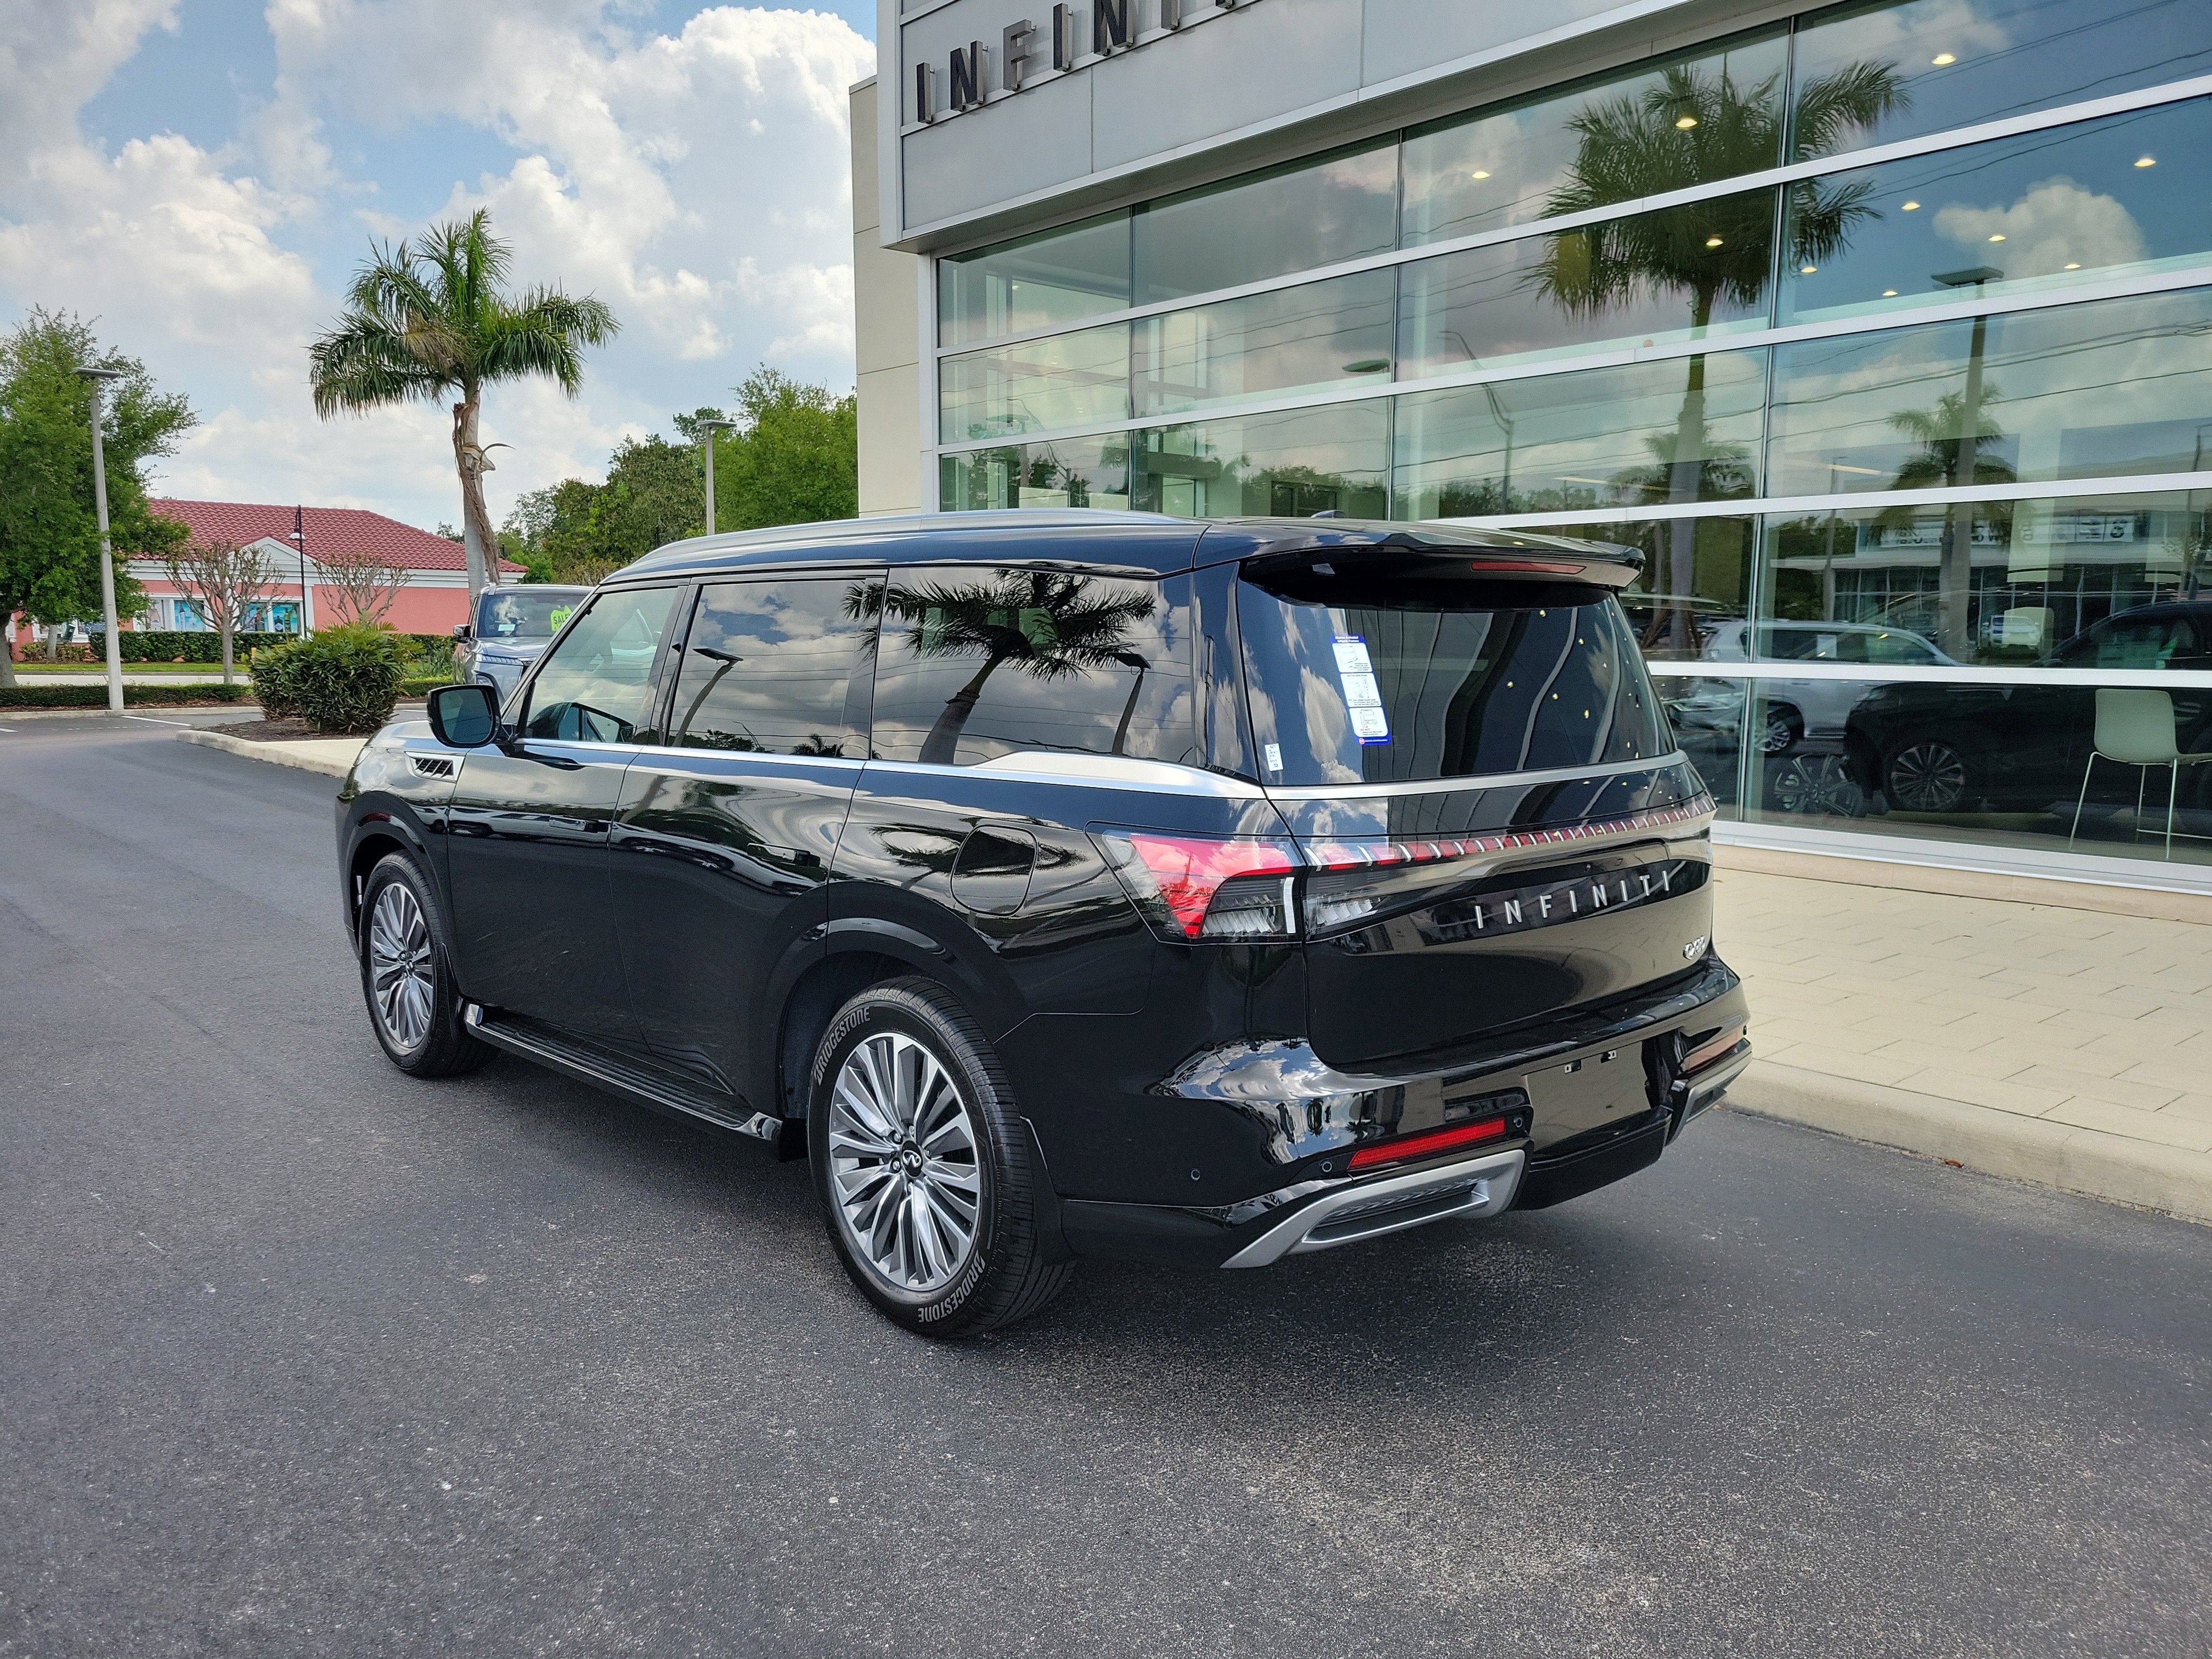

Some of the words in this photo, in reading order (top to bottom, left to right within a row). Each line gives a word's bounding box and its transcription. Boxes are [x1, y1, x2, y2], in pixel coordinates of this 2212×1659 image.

[916, 0, 1234, 124] INFIN
[1475, 870, 1669, 929] INFINITI
[814, 1006, 871, 1087] BRIDGESTONE
[918, 1249, 986, 1323] BRIDGESTONE
